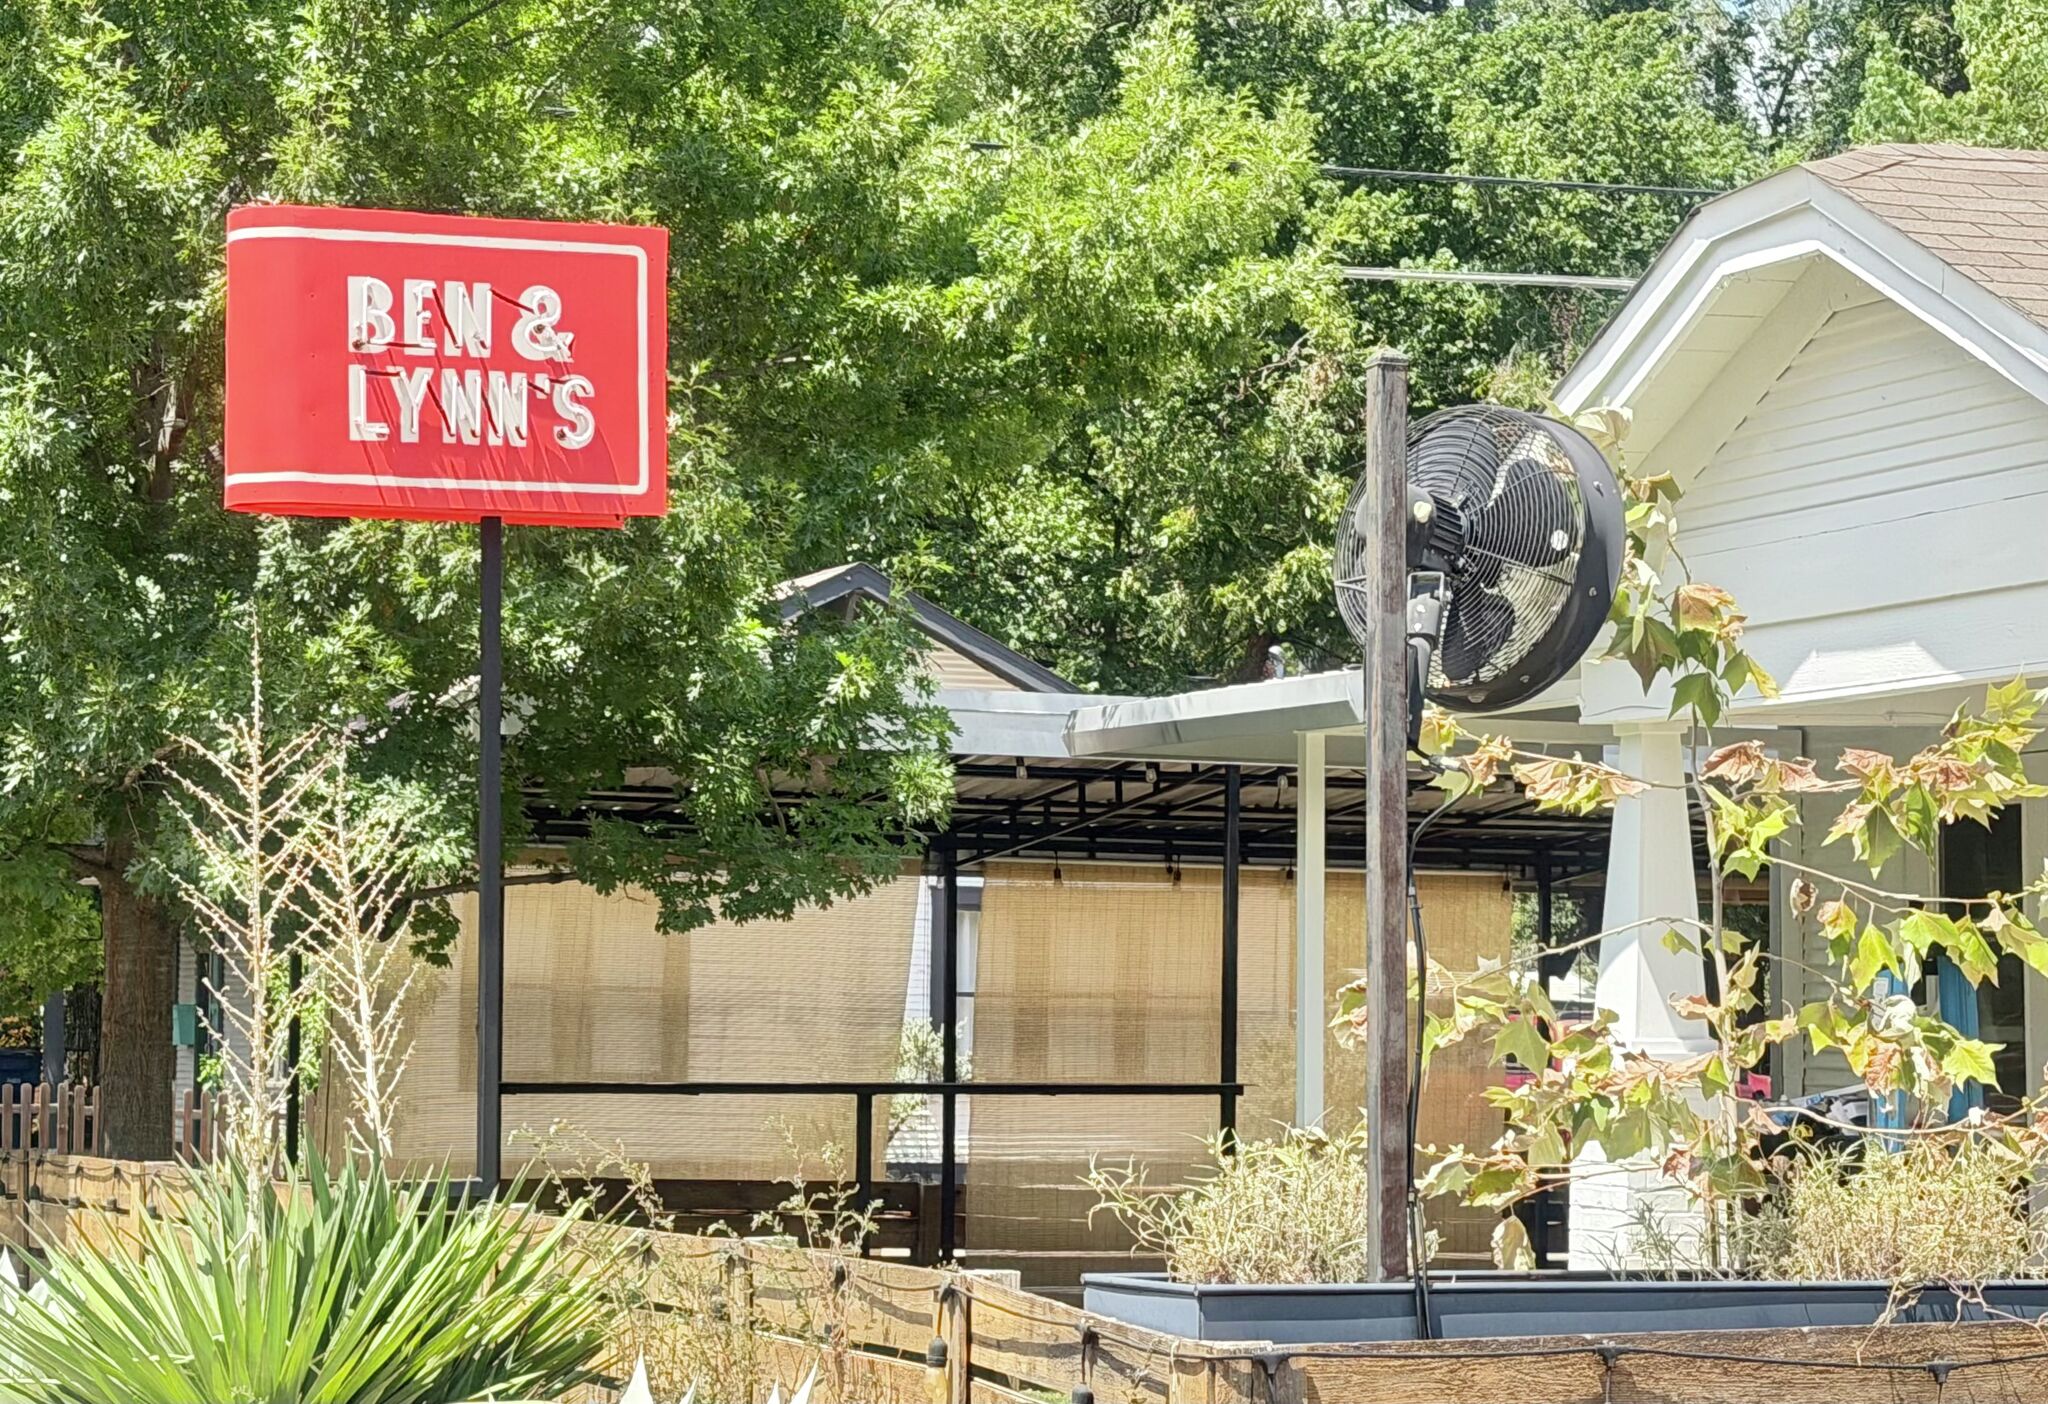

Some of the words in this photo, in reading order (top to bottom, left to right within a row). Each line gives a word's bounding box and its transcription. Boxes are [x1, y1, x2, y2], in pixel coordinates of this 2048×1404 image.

[347, 275, 493, 358] BEN
[511, 285, 575, 363] &
[348, 364, 595, 450] LYNN'S
